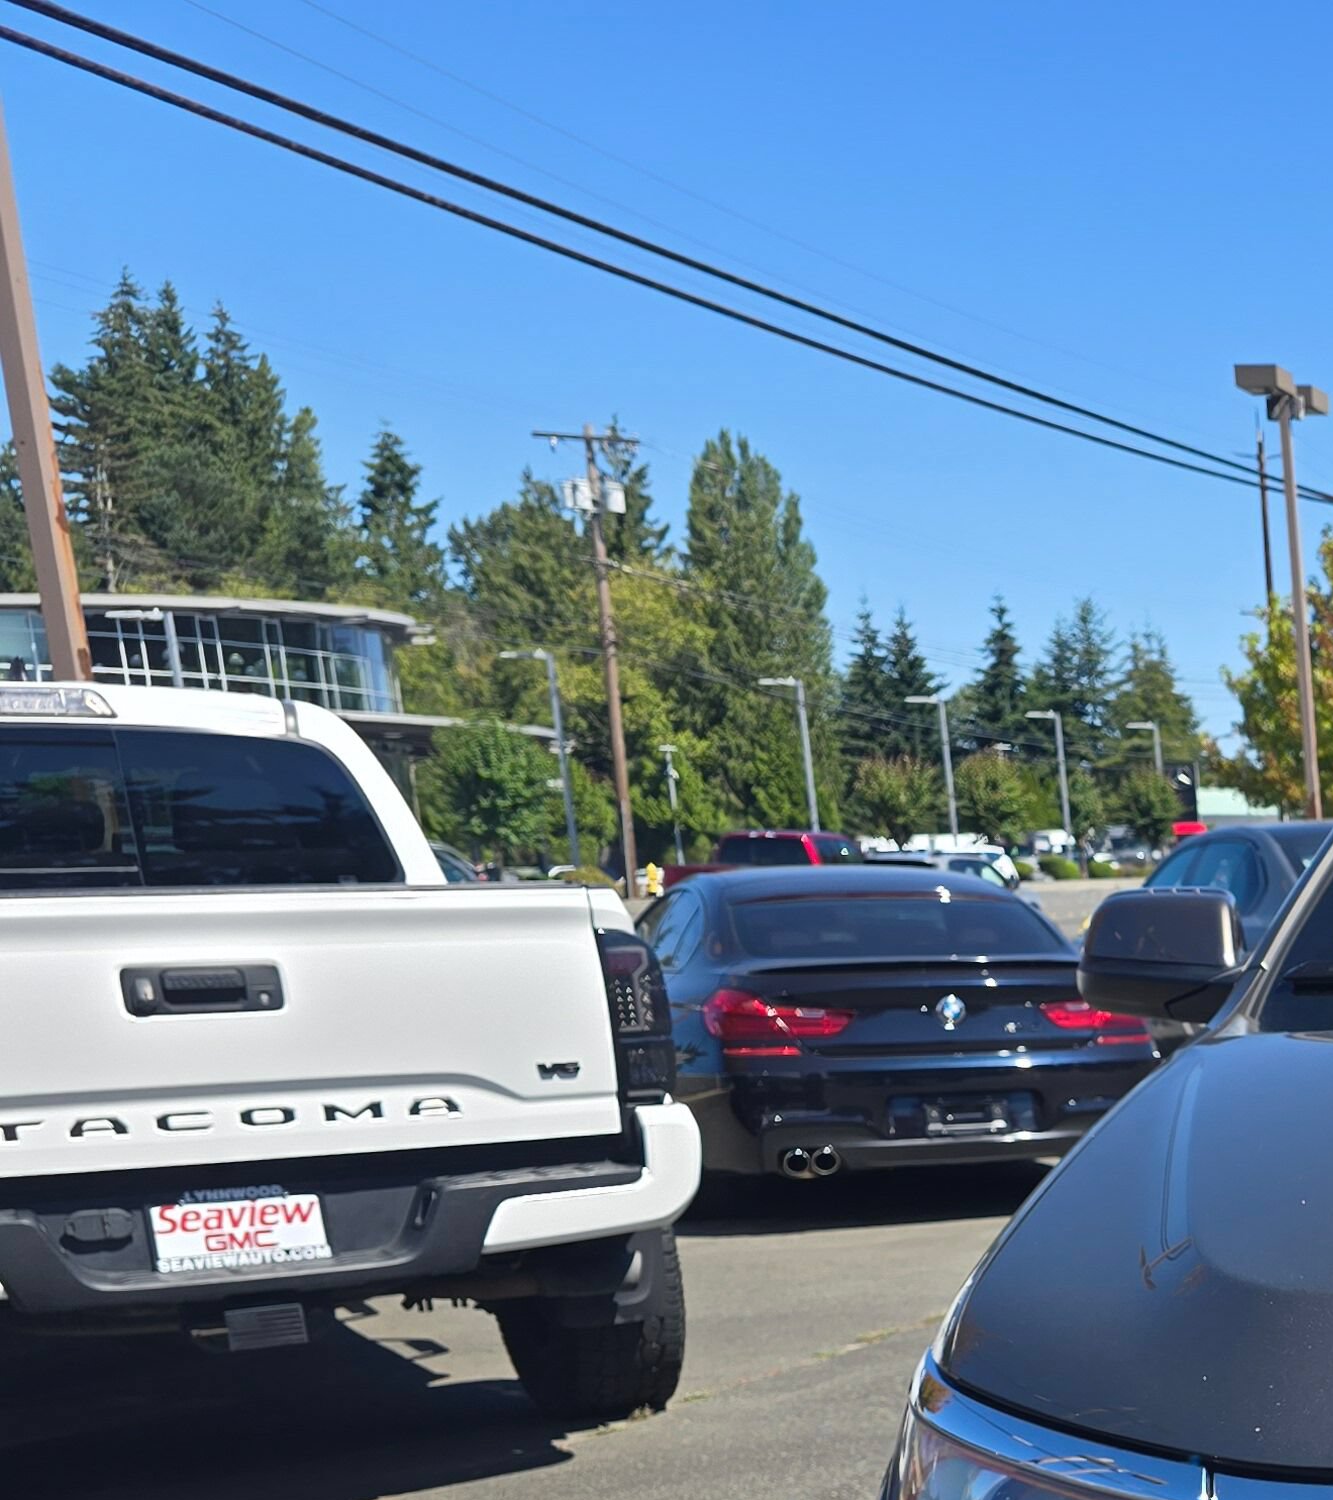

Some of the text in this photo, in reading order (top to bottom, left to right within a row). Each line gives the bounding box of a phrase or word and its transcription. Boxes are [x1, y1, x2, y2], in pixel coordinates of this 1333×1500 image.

[536, 1062, 581, 1081] V6
[0, 1096, 463, 1142] TACOMA
[156, 1199, 315, 1235] Seaview
[204, 1230, 280, 1252] GMC
[156, 1243, 333, 1274] SEAVIEWAUTO.COM
